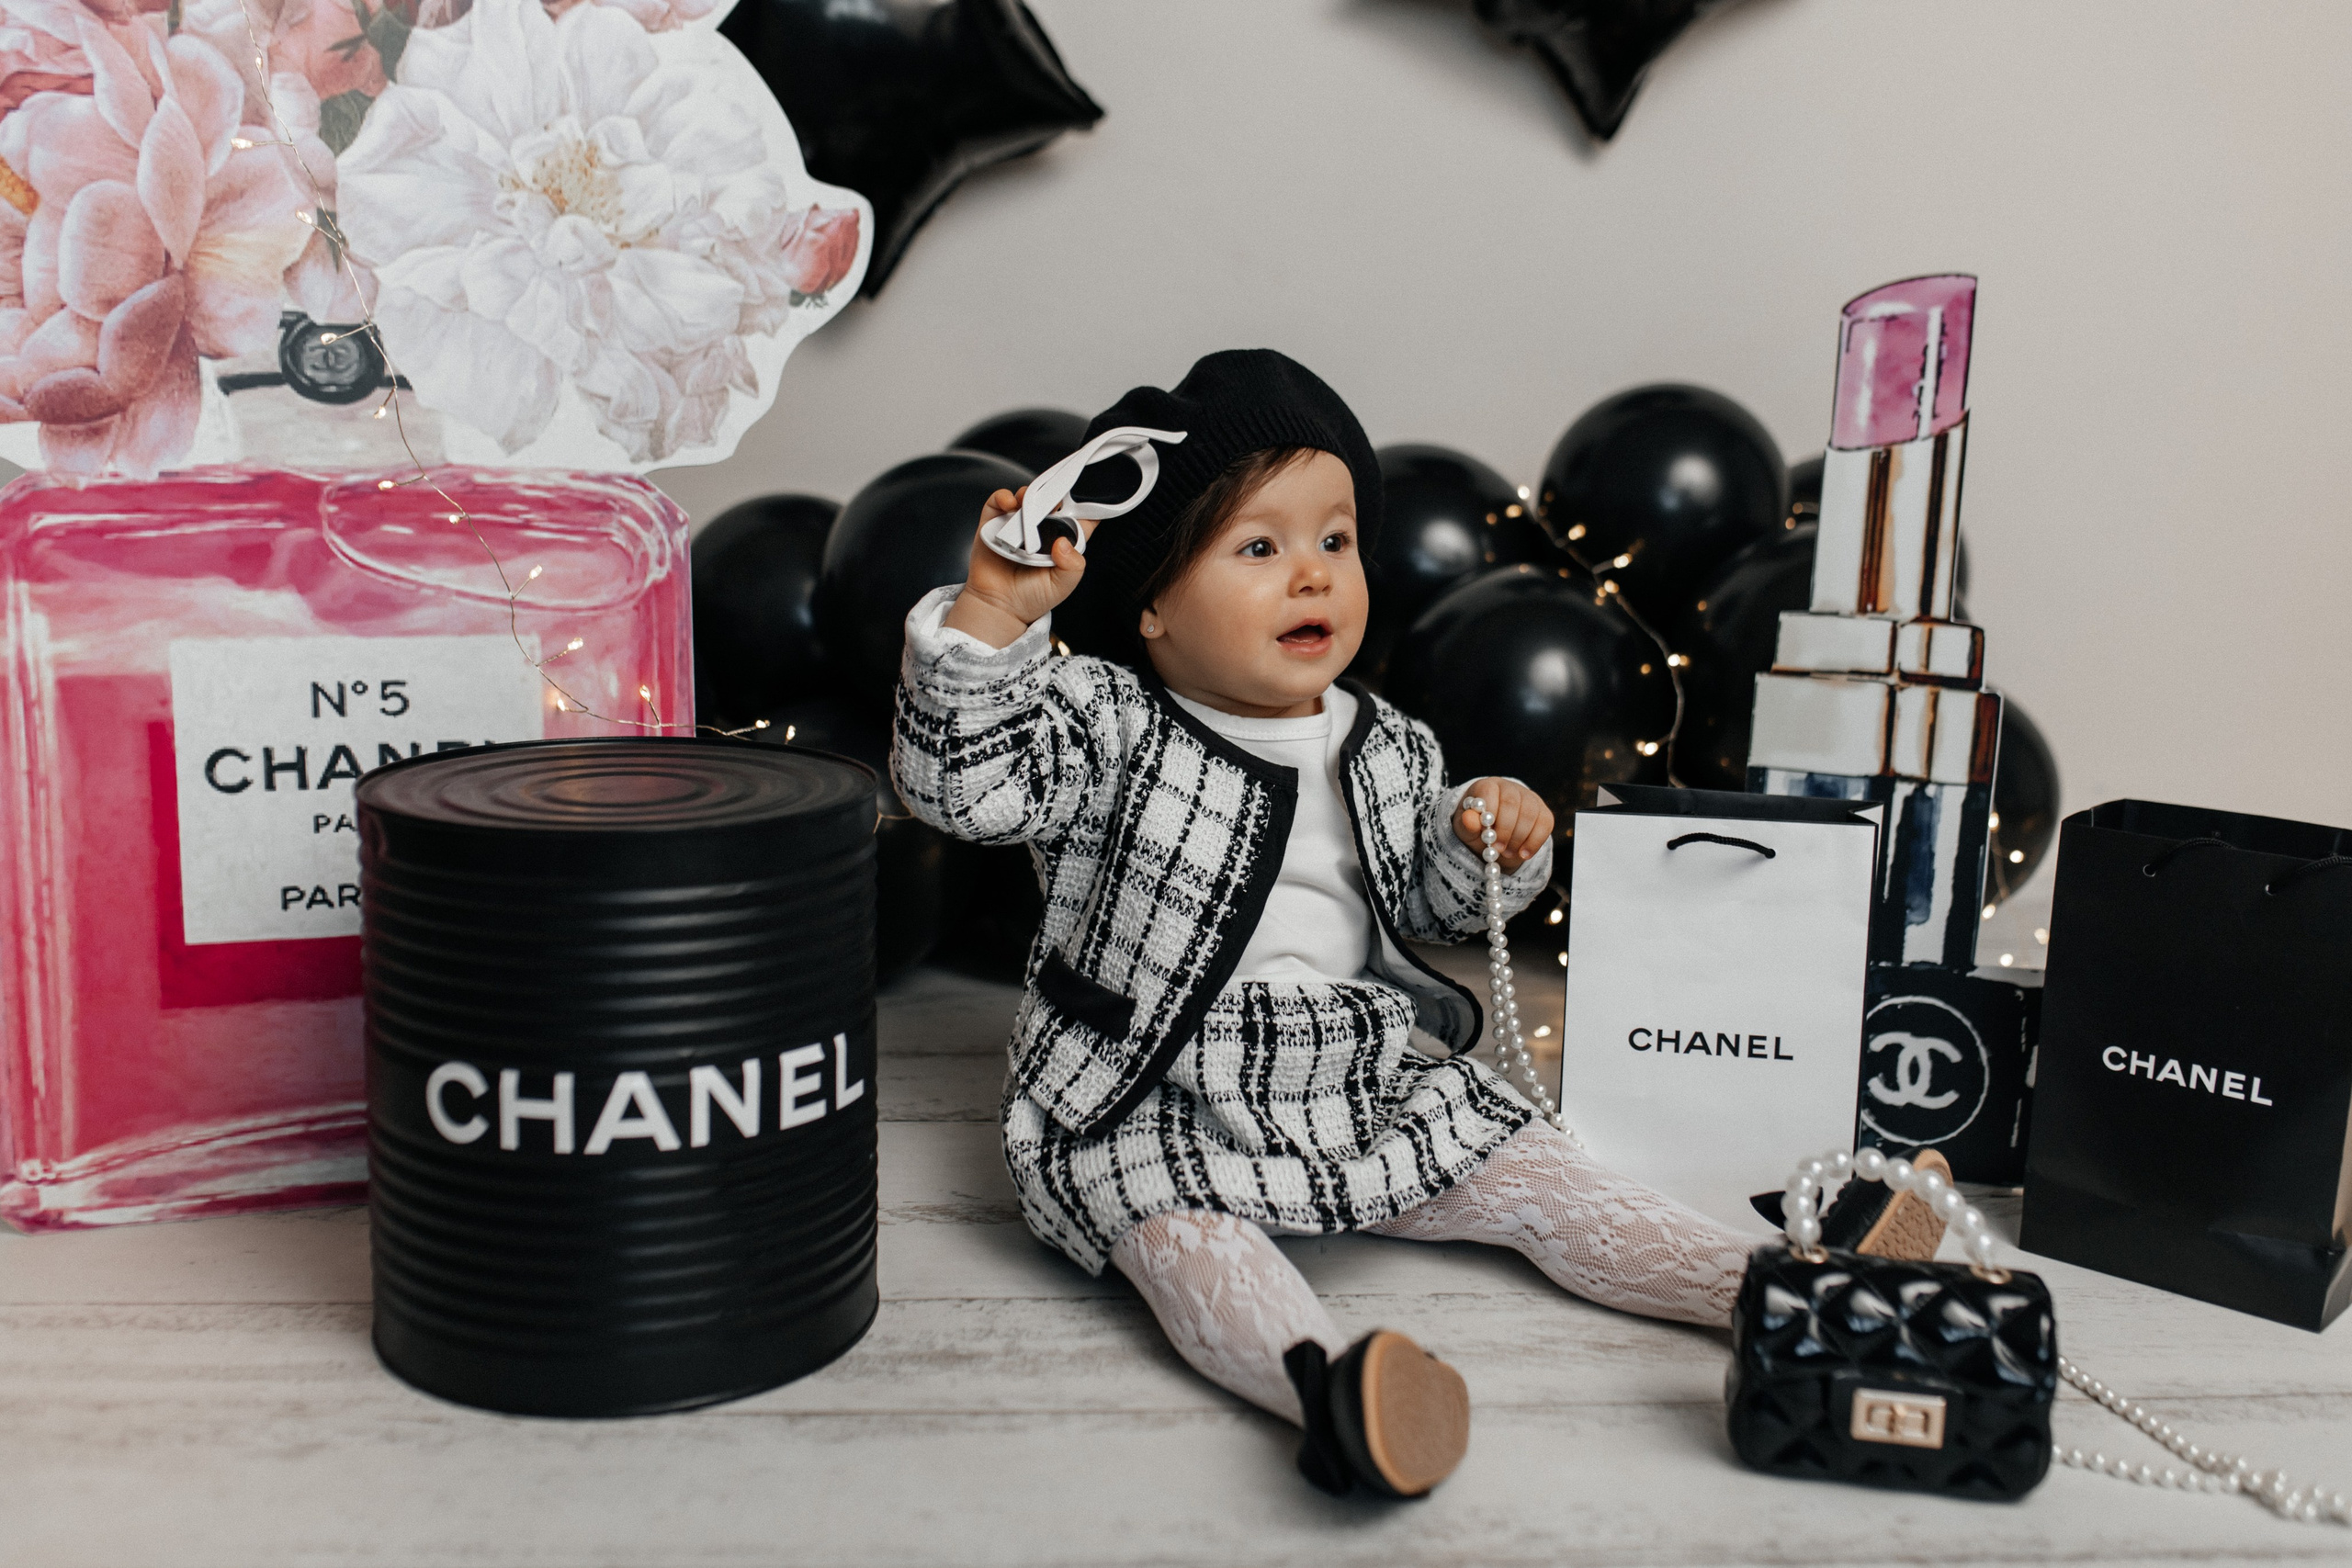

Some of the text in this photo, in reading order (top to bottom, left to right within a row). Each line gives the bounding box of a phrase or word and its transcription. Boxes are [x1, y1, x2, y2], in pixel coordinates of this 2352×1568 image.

[312, 813, 357, 834] PA
[280, 883, 362, 912] PAR
[1627, 1027, 1794, 1061] CHANEL
[2102, 1045, 2273, 1107] CHANEL
[425, 1032, 865, 1156] CHANEL
